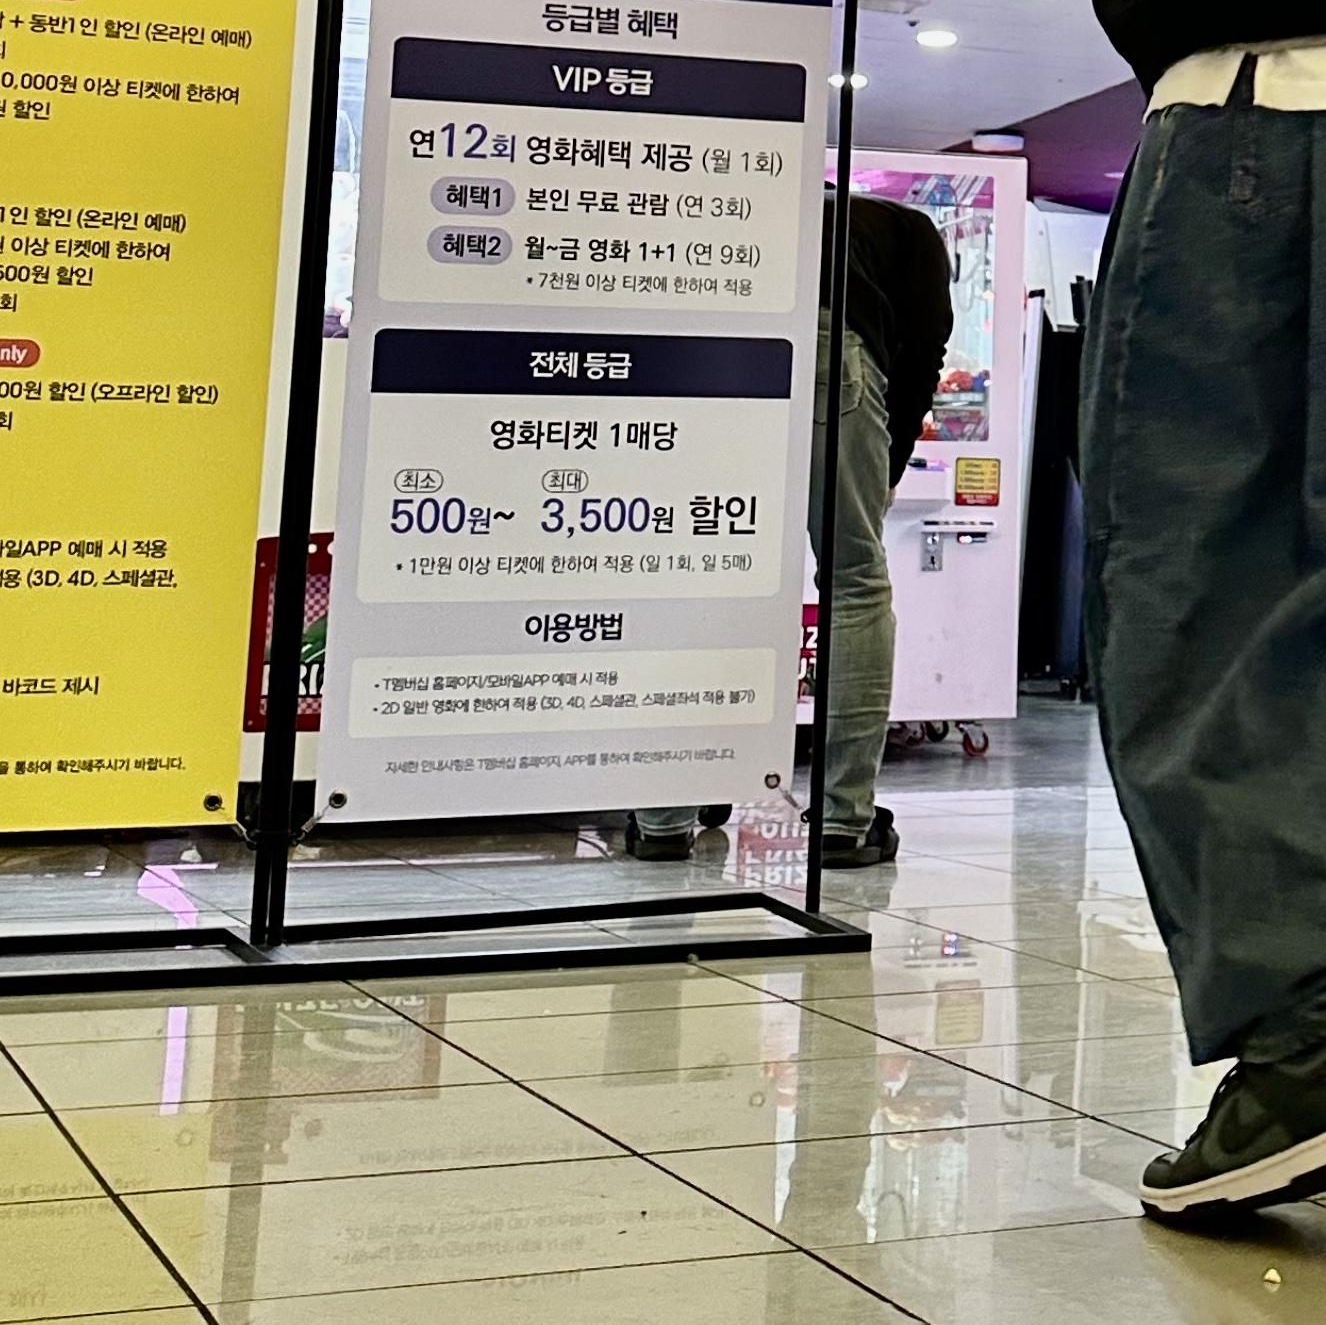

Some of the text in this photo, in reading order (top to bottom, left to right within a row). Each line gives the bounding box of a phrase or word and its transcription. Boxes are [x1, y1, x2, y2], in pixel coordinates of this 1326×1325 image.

[104, 19, 140, 40] 할인
[145, 22, 204, 45] (온라인
[211, 27, 252, 49] 예매)
[543, 3, 678, 39] 등급별 혜택
[84, 77, 121, 96] 이상
[126, 80, 180, 101] 티켓에
[186, 84, 240, 105] 한하여
[551, 64, 654, 96] VIP 등급
[13, 99, 51, 121] 할인
[409, 122, 783, 177] 연12회 영화혜택 제공 (월 1회)
[446, 182, 752, 221] 혜택1 본인 무료 관람 (연 3회)
[34, 207, 72, 228] 할인
[77, 208, 138, 231] (온라인
[144, 213, 187, 234] 예매)
[11, 235, 50, 257] 이상
[55, 237, 111, 259] 티켓에
[115, 239, 171, 261] 한하여
[442, 232, 761, 268] 혜택2 월~금 영화 1+1 (연 9회)
[56, 265, 93, 287] 할인
[538, 272, 753, 297] 7천원 이상 티켓에 한하여 적용
[529, 351, 633, 380] 전체 등급
[48, 381, 86, 402] 할인
[90, 381, 171, 404] (오프라인
[176, 383, 219, 405] 할인)
[490, 419, 679, 452] 영화티켓 1매당
[401, 471, 583, 491] 최소 최대
[540, 496, 675, 539] 3,500원
[689, 496, 758, 536] 할인
[0, 538, 167, 559] 일APP 예매 시 적용
[409, 555, 453, 575] 1만원
[458, 555, 491, 575] 이상
[497, 555, 545, 575] 티켓에
[551, 554, 600, 575] 한하여
[603, 553, 635, 574] 적용
[639, 554, 661, 574] (일
[701, 553, 718, 573] 일
[721, 553, 753, 573] 5매)
[68, 570, 98, 589] 4D,
[525, 613, 624, 643] 이용방법
[2, 676, 100, 696] 바코드 제시
[382, 676, 430, 693] T멤버십
[580, 672, 593, 686] 시
[596, 670, 619, 686] 적용
[381, 701, 400, 715] 2D
[403, 700, 429, 715] 일반
[473, 698, 510, 713] 한하여
[513, 696, 538, 711] 적용
[15, 759, 52, 775] 통하여
[57, 757, 131, 774] 확인해주시기
